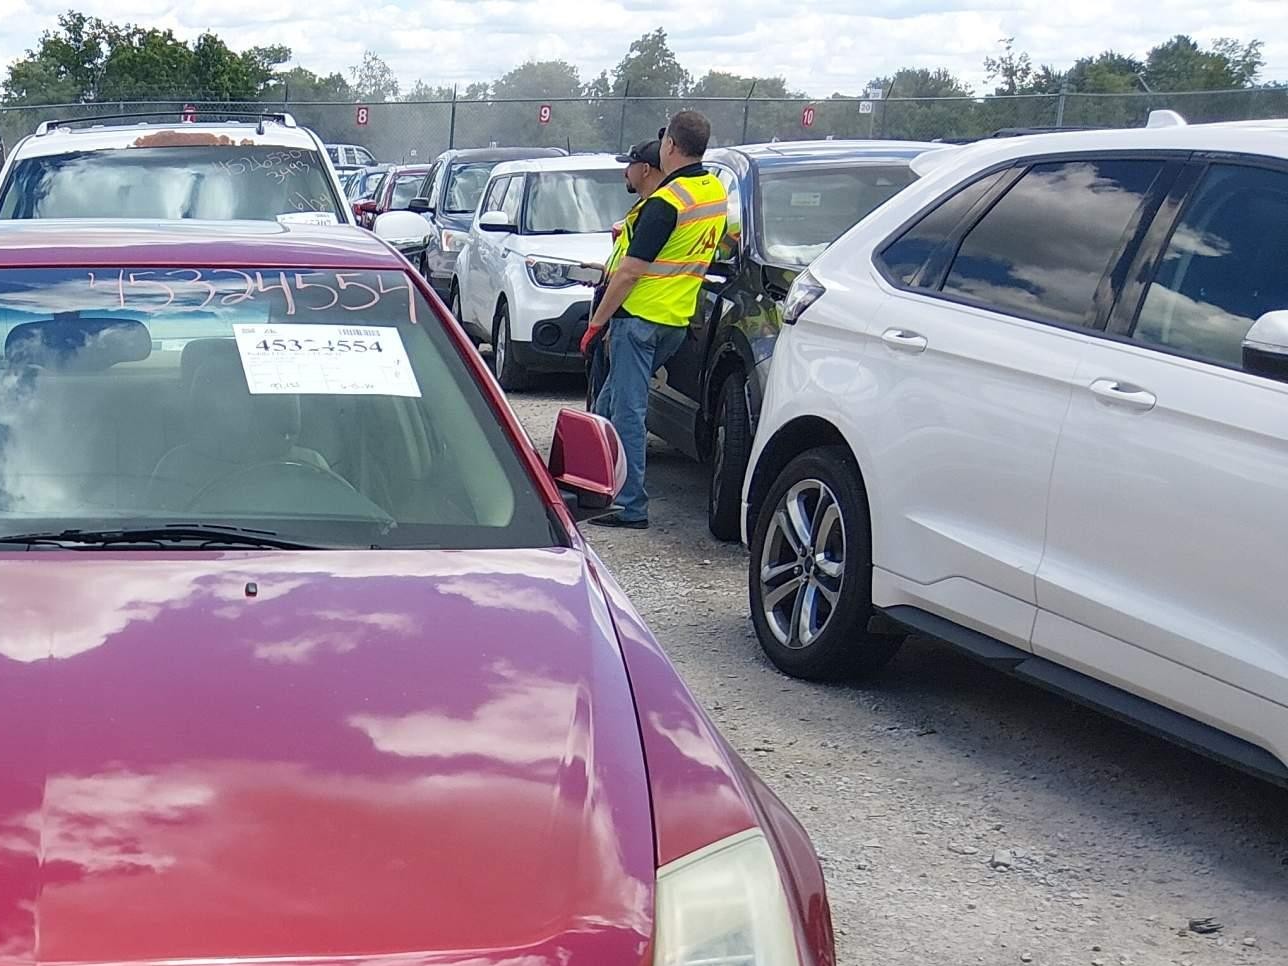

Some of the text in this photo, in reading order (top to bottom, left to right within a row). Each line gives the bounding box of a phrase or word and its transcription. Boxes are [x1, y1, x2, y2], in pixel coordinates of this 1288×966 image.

[358, 108, 368, 124] 8
[540, 105, 550, 121] 9
[803, 109, 814, 125] 10
